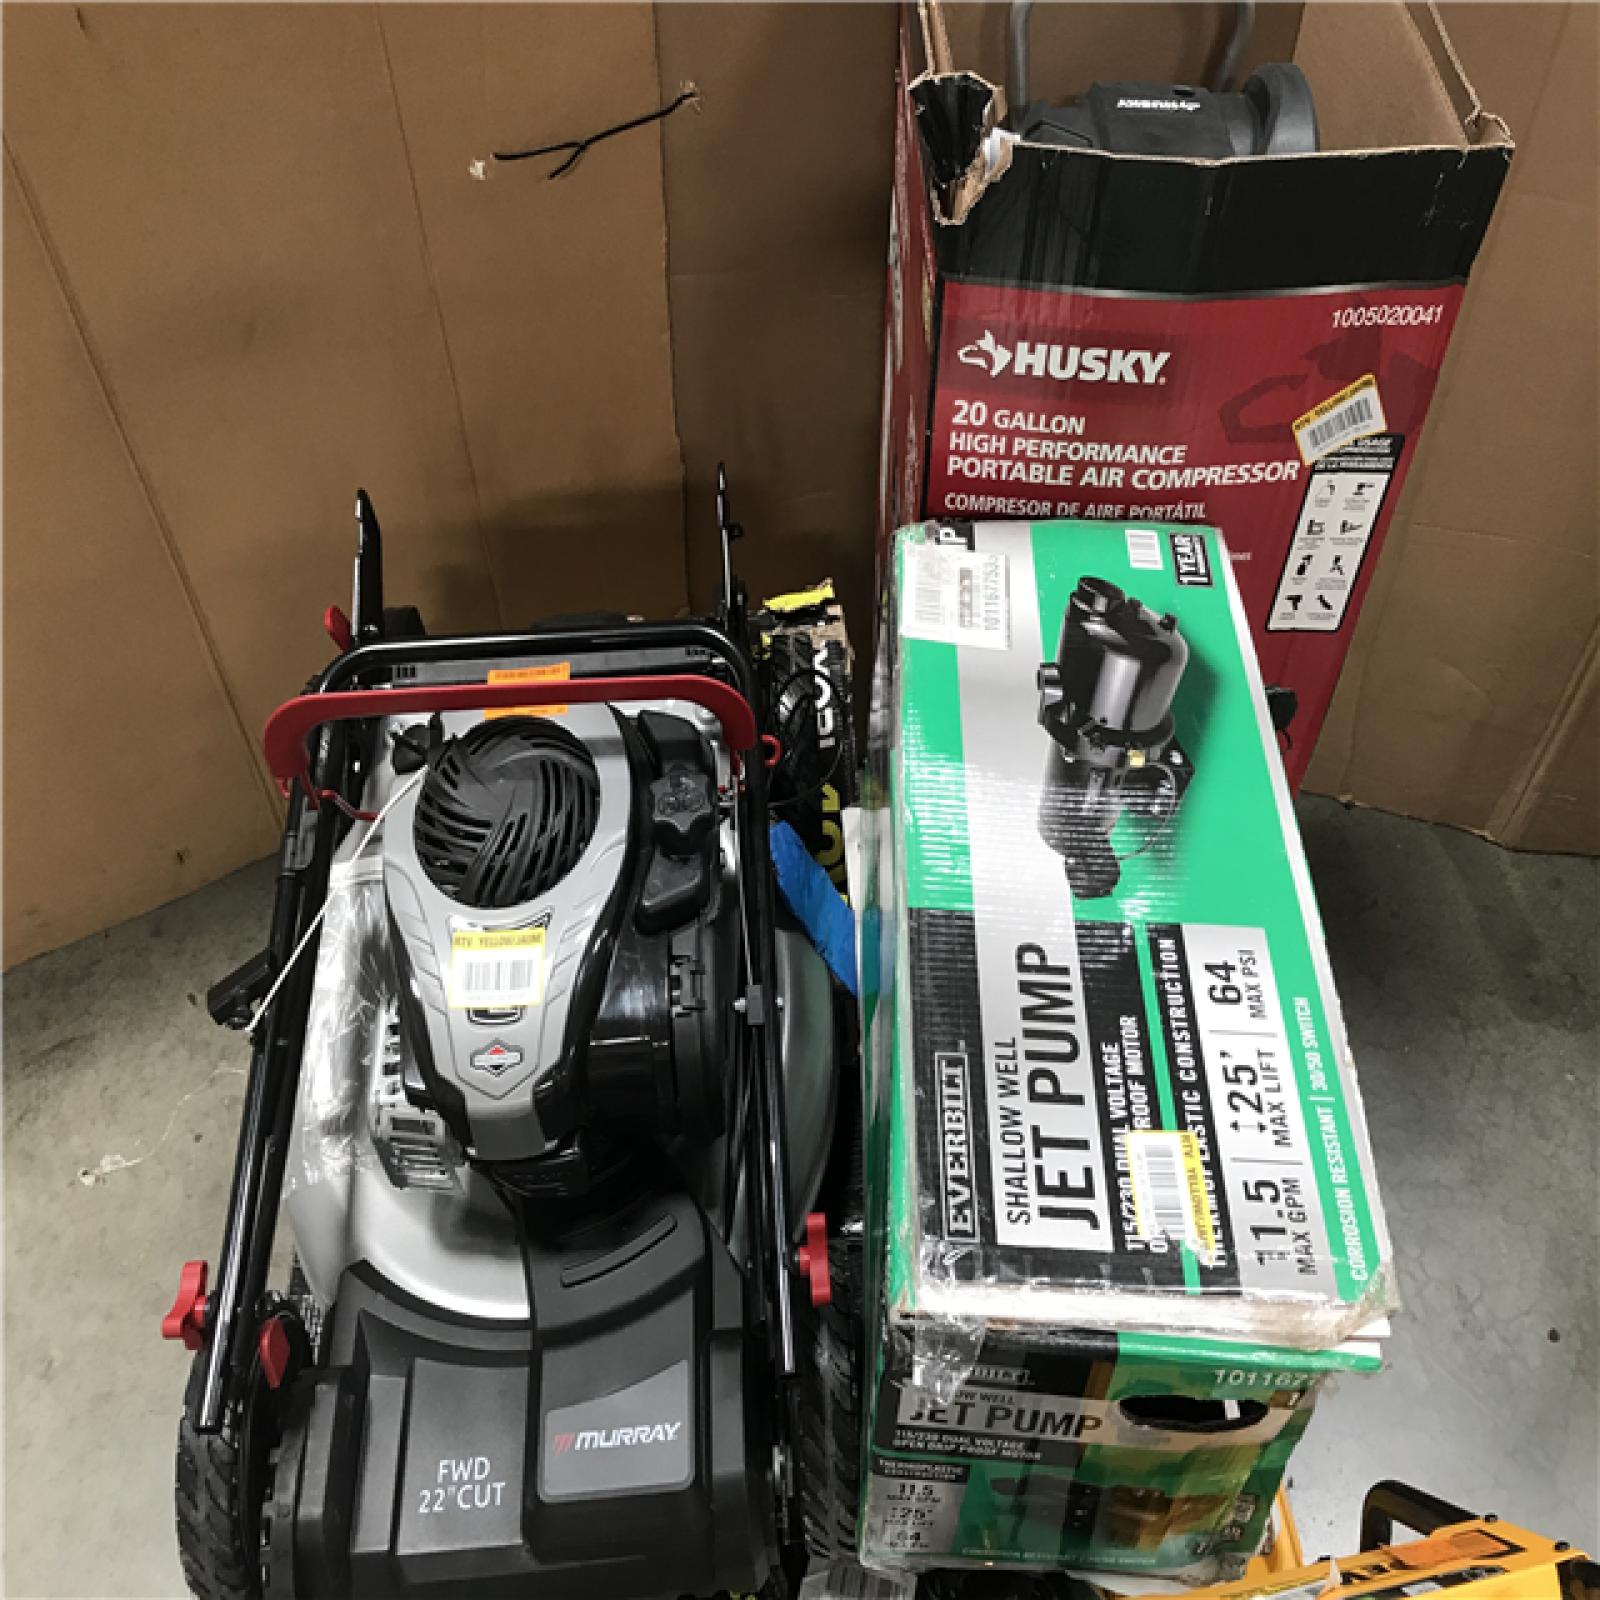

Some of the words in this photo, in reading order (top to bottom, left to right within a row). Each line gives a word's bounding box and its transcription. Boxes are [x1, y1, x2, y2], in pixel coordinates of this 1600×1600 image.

[1331, 305, 1444, 328] 1005020041
[1013, 341, 1171, 385] HUSKY
[951, 399, 988, 426] 20
[992, 409, 1086, 435] GALLON
[949, 431, 1006, 456] HIGH
[1011, 436, 1188, 466] PERFORMANCE
[946, 454, 1075, 486] PORTABLE
[1079, 466, 1125, 489] AIR
[1131, 461, 1300, 492] COMPRESSOR
[943, 491, 1052, 516] COMPRESOR
[1055, 502, 1081, 518] DE
[1205, 961, 1243, 1005] 64
[1237, 950, 1260, 978] PSI
[1015, 942, 1086, 1106] PUMP
[1158, 937, 1199, 1083] CONSTRUCTION
[1248, 982, 1267, 1020] MAX
[994, 1036, 1021, 1099] WELL
[1120, 1014, 1145, 1076] MOTOR
[1102, 1041, 1127, 1121] VOLTAGE
[1256, 1047, 1283, 1094] LIFT
[941, 1059, 974, 1234] EVERBILT
[1268, 1101, 1293, 1149] MAX
[1315, 1104, 1348, 1185] RESISTANT
[999, 1105, 1030, 1226] SHALLOW
[1030, 1124, 1101, 1231] JET
[1242, 1179, 1291, 1266] 11.5
[1281, 1177, 1309, 1224] GPM
[1291, 1231, 1319, 1276] MAX
[1334, 1188, 1368, 1282] CORROSION
[574, 1421, 682, 1451] MURRAY
[984, 1403, 1104, 1438] PUMP
[436, 1456, 491, 1484] FWD
